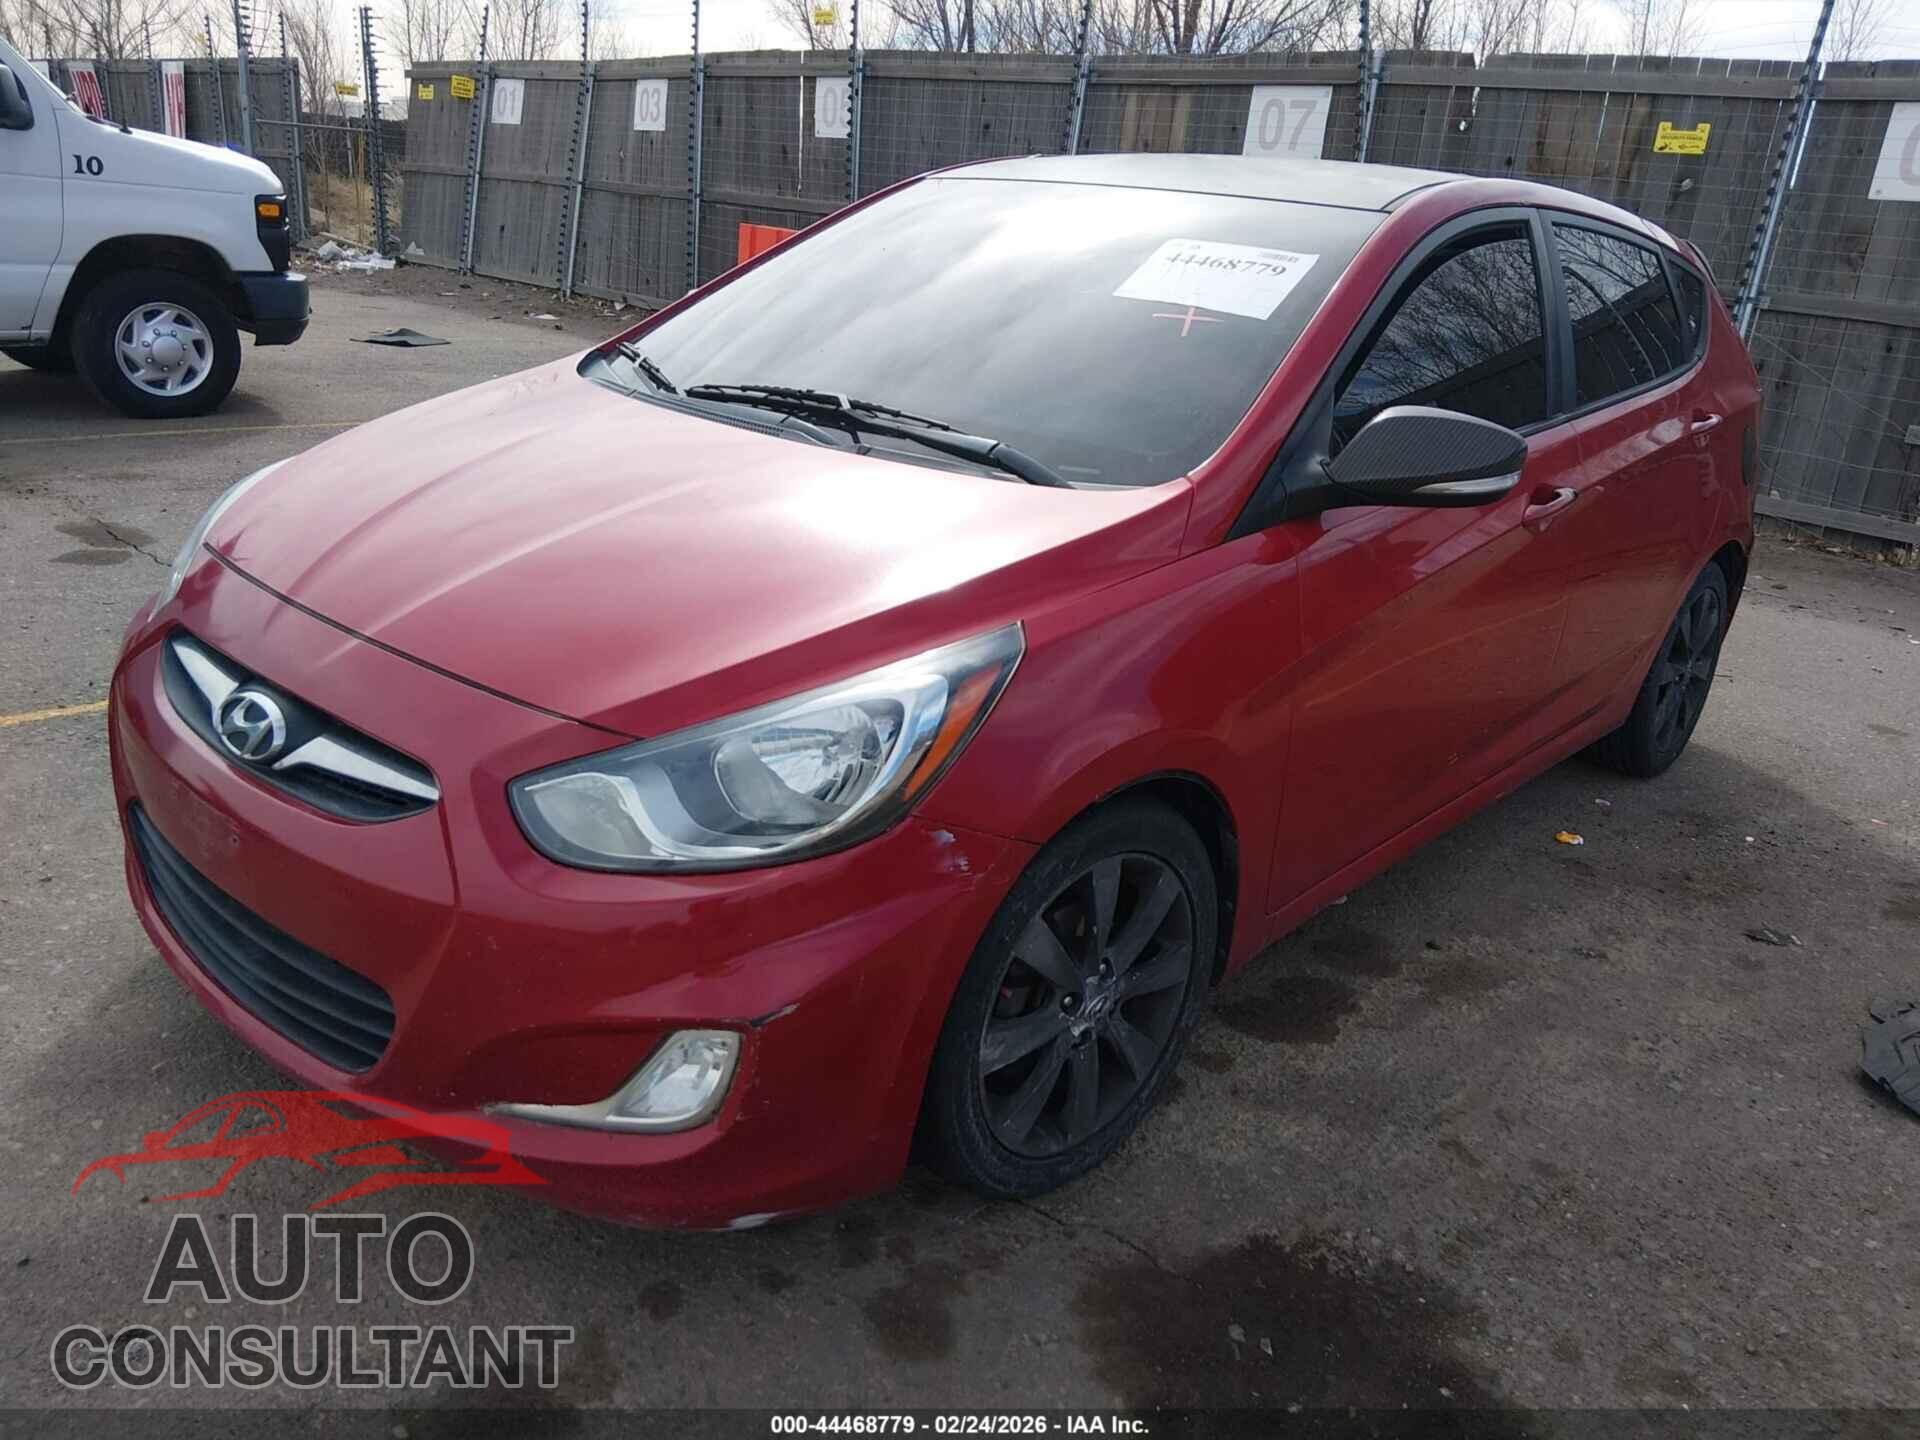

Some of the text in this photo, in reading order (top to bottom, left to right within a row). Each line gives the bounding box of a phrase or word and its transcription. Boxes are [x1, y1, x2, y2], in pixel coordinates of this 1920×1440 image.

[639, 87, 661, 122] 03
[1258, 98, 1319, 152] 07
[72, 153, 104, 176] 10
[1165, 251, 1288, 277] 44468779
